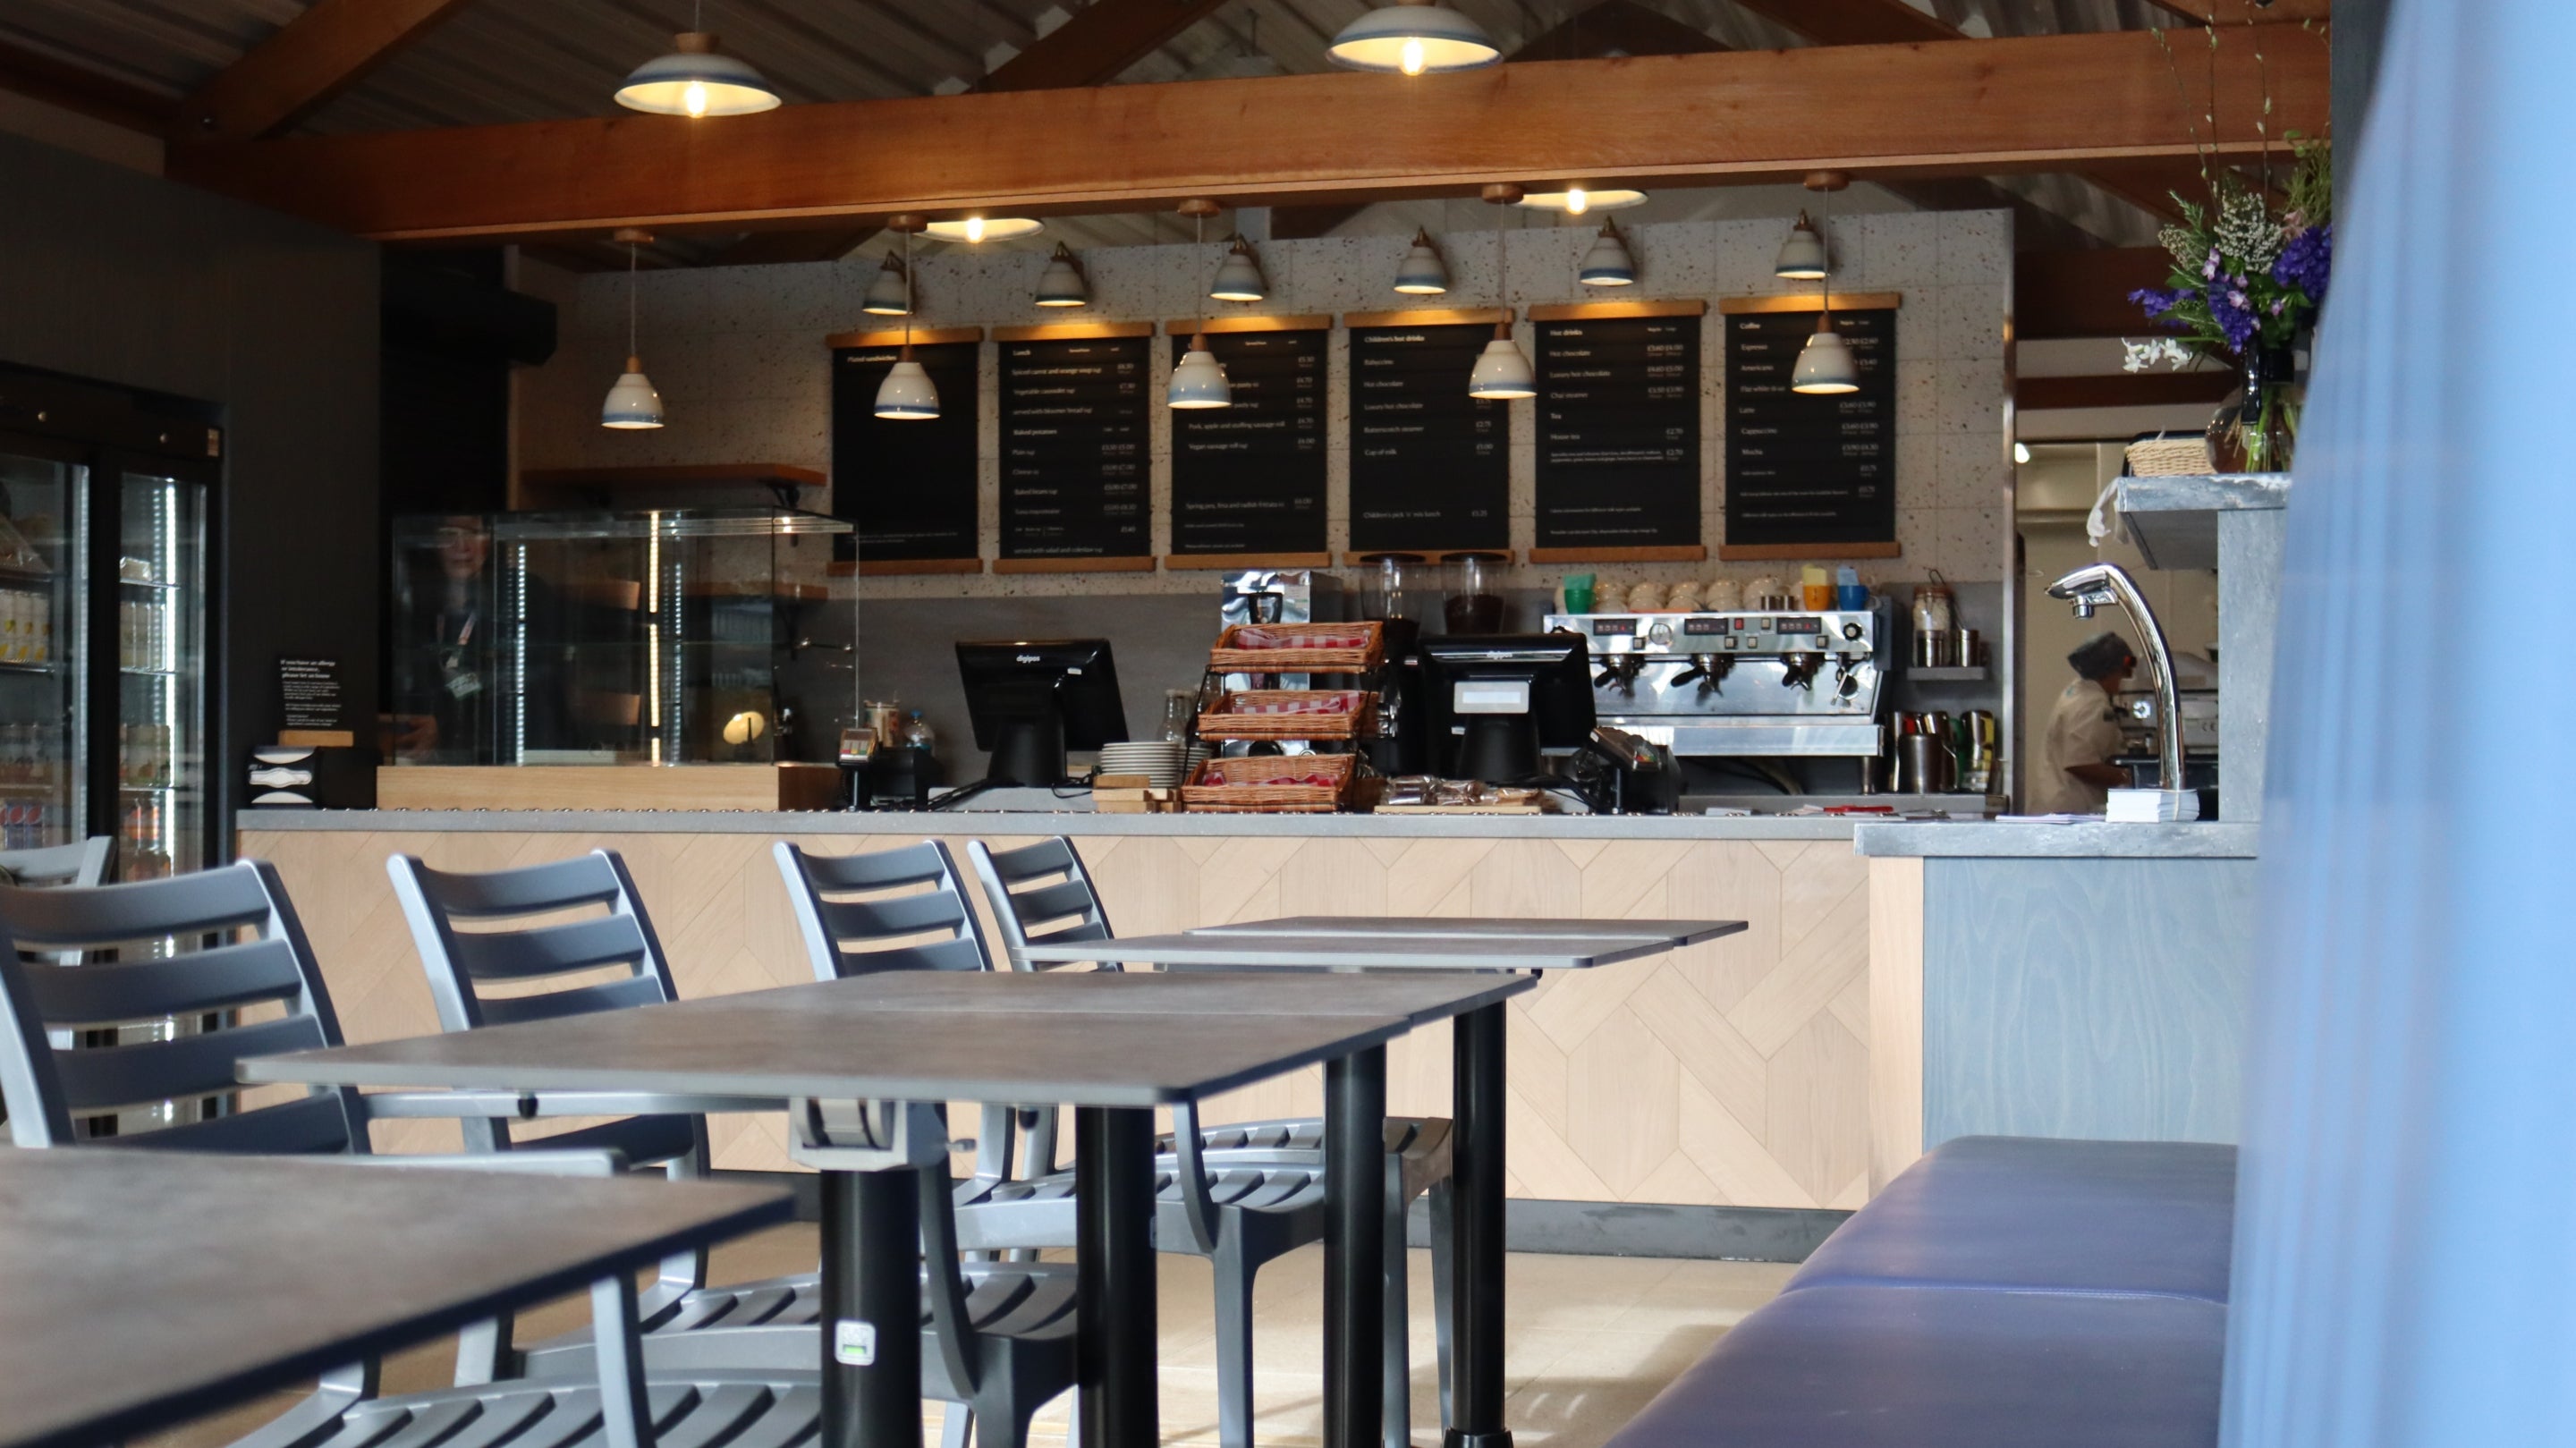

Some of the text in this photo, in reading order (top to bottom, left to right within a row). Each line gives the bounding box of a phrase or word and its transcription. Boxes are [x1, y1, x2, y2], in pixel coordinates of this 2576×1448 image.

[1739, 322, 1761, 330] Coffee
[1549, 371, 1570, 379] Luxury
[1016, 655, 1040, 664] digipos
